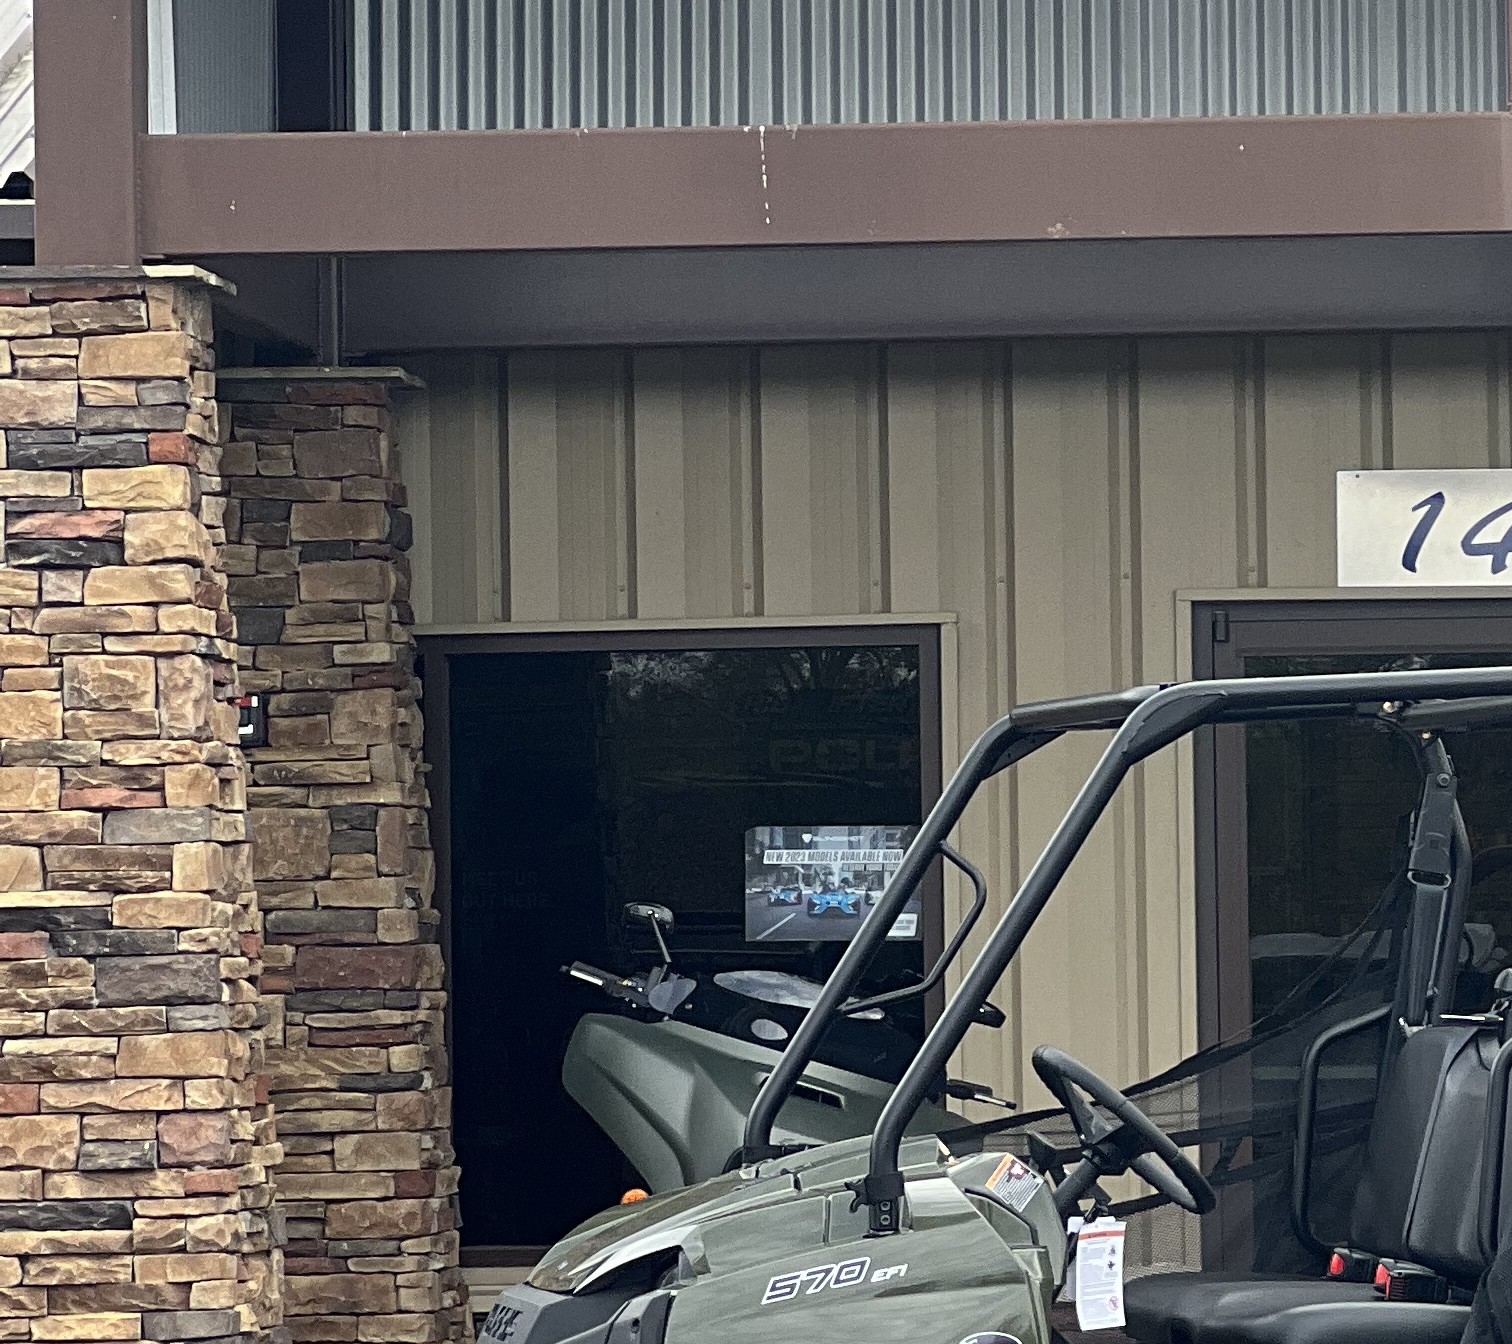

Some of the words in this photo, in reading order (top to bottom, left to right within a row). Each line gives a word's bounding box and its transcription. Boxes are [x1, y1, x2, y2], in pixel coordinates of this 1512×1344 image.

[765, 851, 784, 863] NEW
[807, 851, 838, 863] MODELS
[840, 851, 880, 863] AVAILABLE
[761, 1256, 871, 1305] 570
[871, 1264, 909, 1283] EFI
